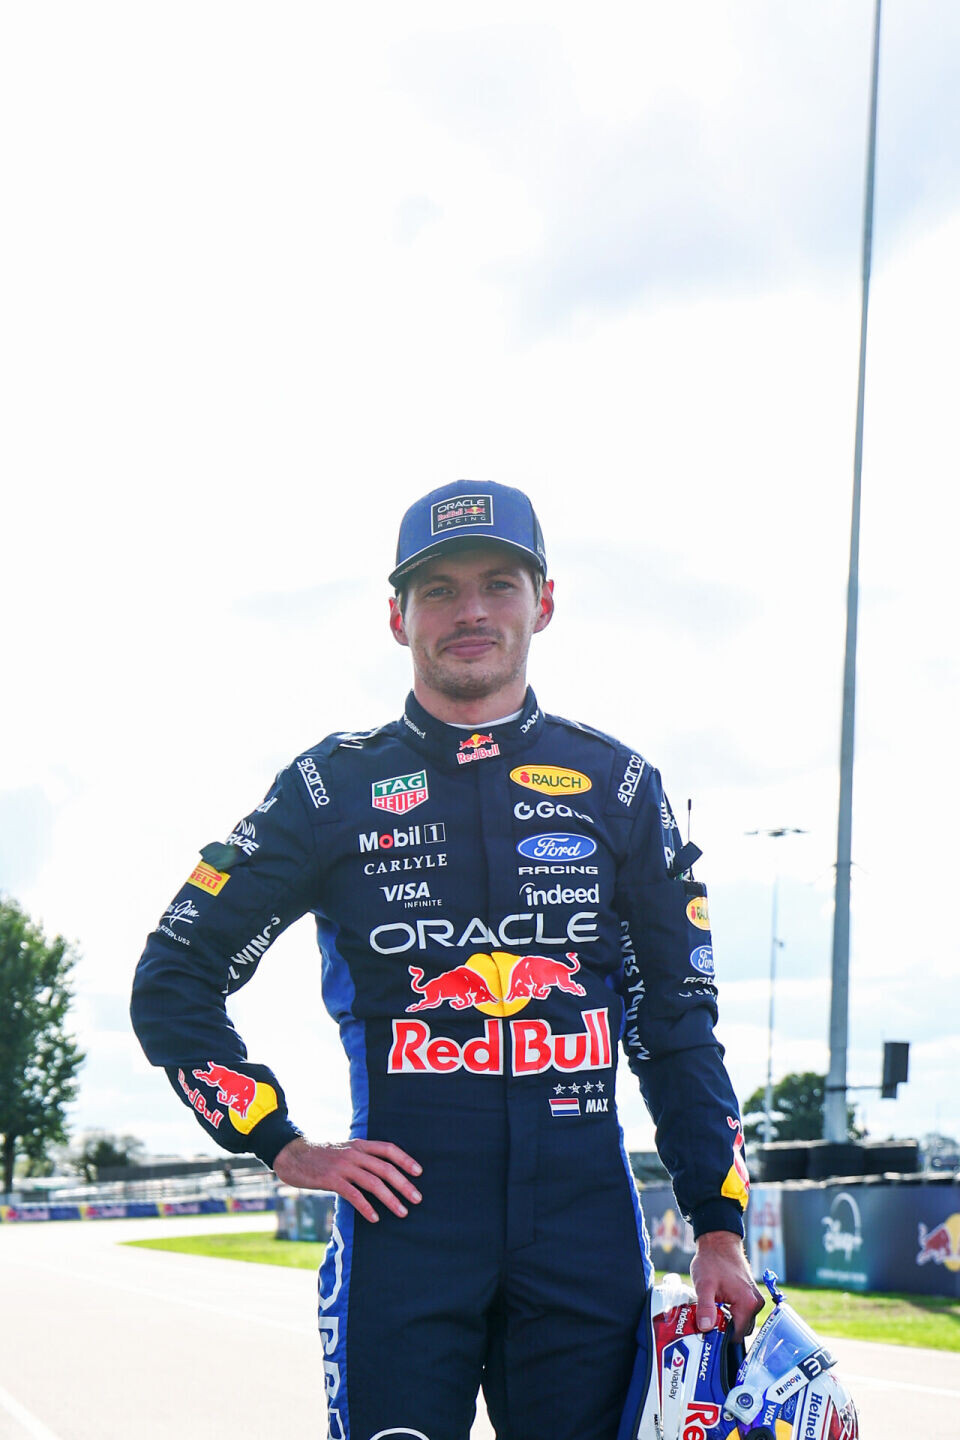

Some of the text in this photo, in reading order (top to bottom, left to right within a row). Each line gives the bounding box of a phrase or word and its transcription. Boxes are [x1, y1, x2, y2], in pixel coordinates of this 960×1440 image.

[437, 499, 486, 513] ORACLE
[437, 516, 486, 528] RACING
[456, 743, 501, 765] Red Bull
[297, 757, 330, 809] sparco
[376, 774, 424, 796] TAG
[531, 773, 582, 789] RAUCH
[617, 754, 646, 807] sparco
[375, 790, 426, 813] HEUER
[359, 825, 421, 853] Mobil
[533, 836, 583, 857] Ford
[363, 853, 448, 876] CARLYLE
[518, 865, 599, 875] RACING
[379, 881, 431, 902] VISA
[524, 883, 600, 906] indeed
[404, 899, 443, 909] INFINITE
[369, 911, 600, 955] ORACLE
[387, 1018, 504, 1076] Red
[509, 1007, 613, 1077] Bull
[585, 1098, 610, 1114] MAX
[674, 1306, 691, 1335] indeed
[698, 1341, 712, 1381] DAMAC
[669, 1367, 681, 1400] viaplay
[783, 1373, 803, 1392] Mobil
[762, 1404, 777, 1425] VISA
